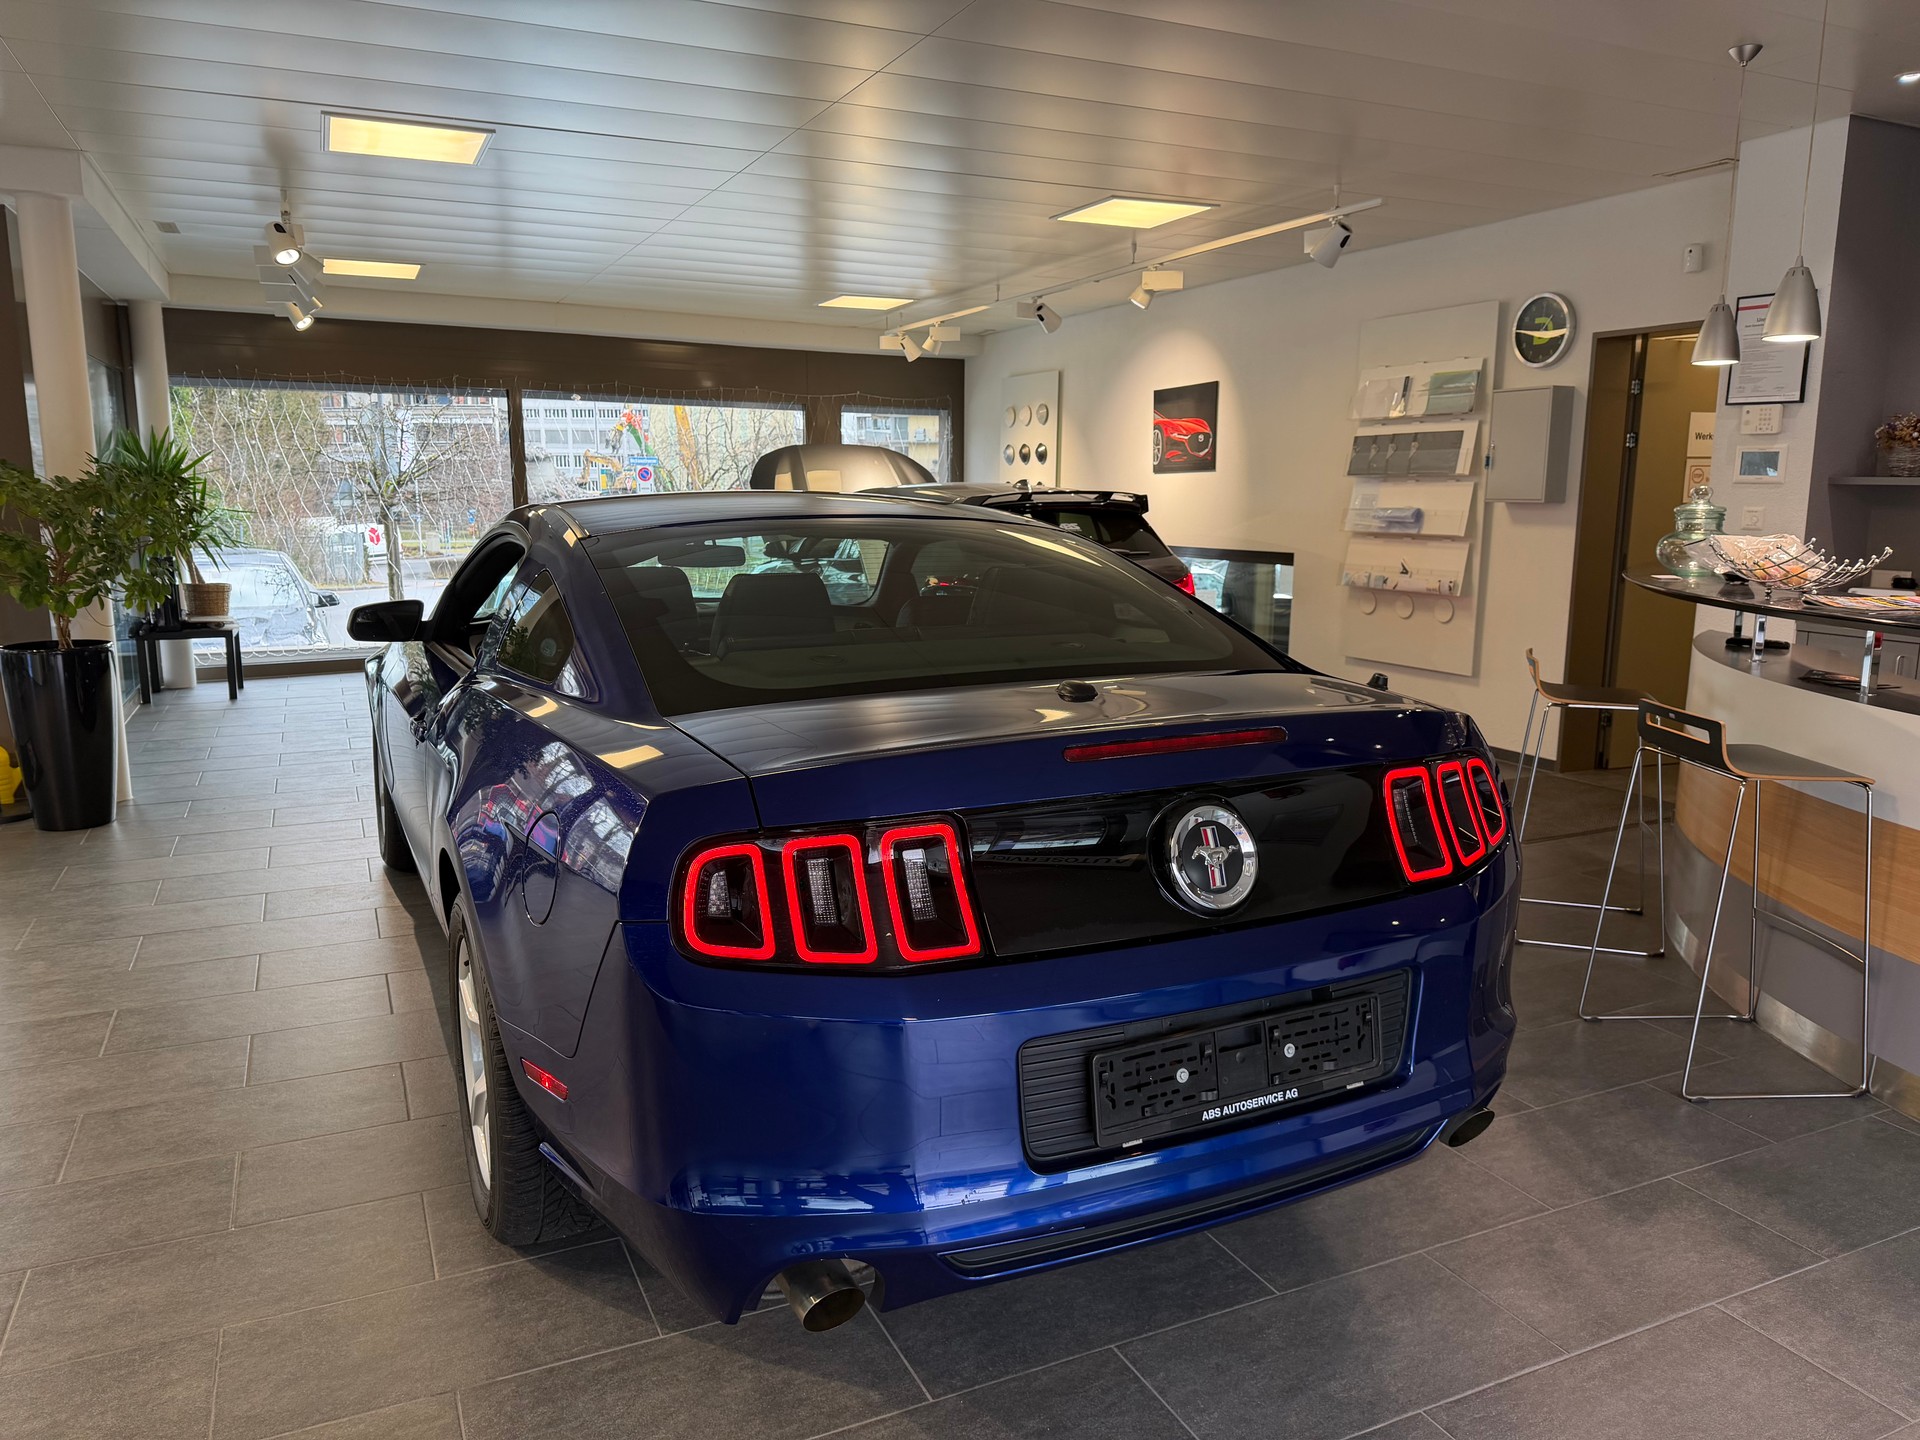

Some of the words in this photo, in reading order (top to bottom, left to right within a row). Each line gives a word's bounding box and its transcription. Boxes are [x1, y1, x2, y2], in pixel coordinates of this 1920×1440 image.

[1695, 432, 1714, 440] Werk
[1202, 1107, 1221, 1121] ABS
[1222, 1091, 1284, 1116] AUTOSERVICE
[1285, 1088, 1298, 1100] AG
